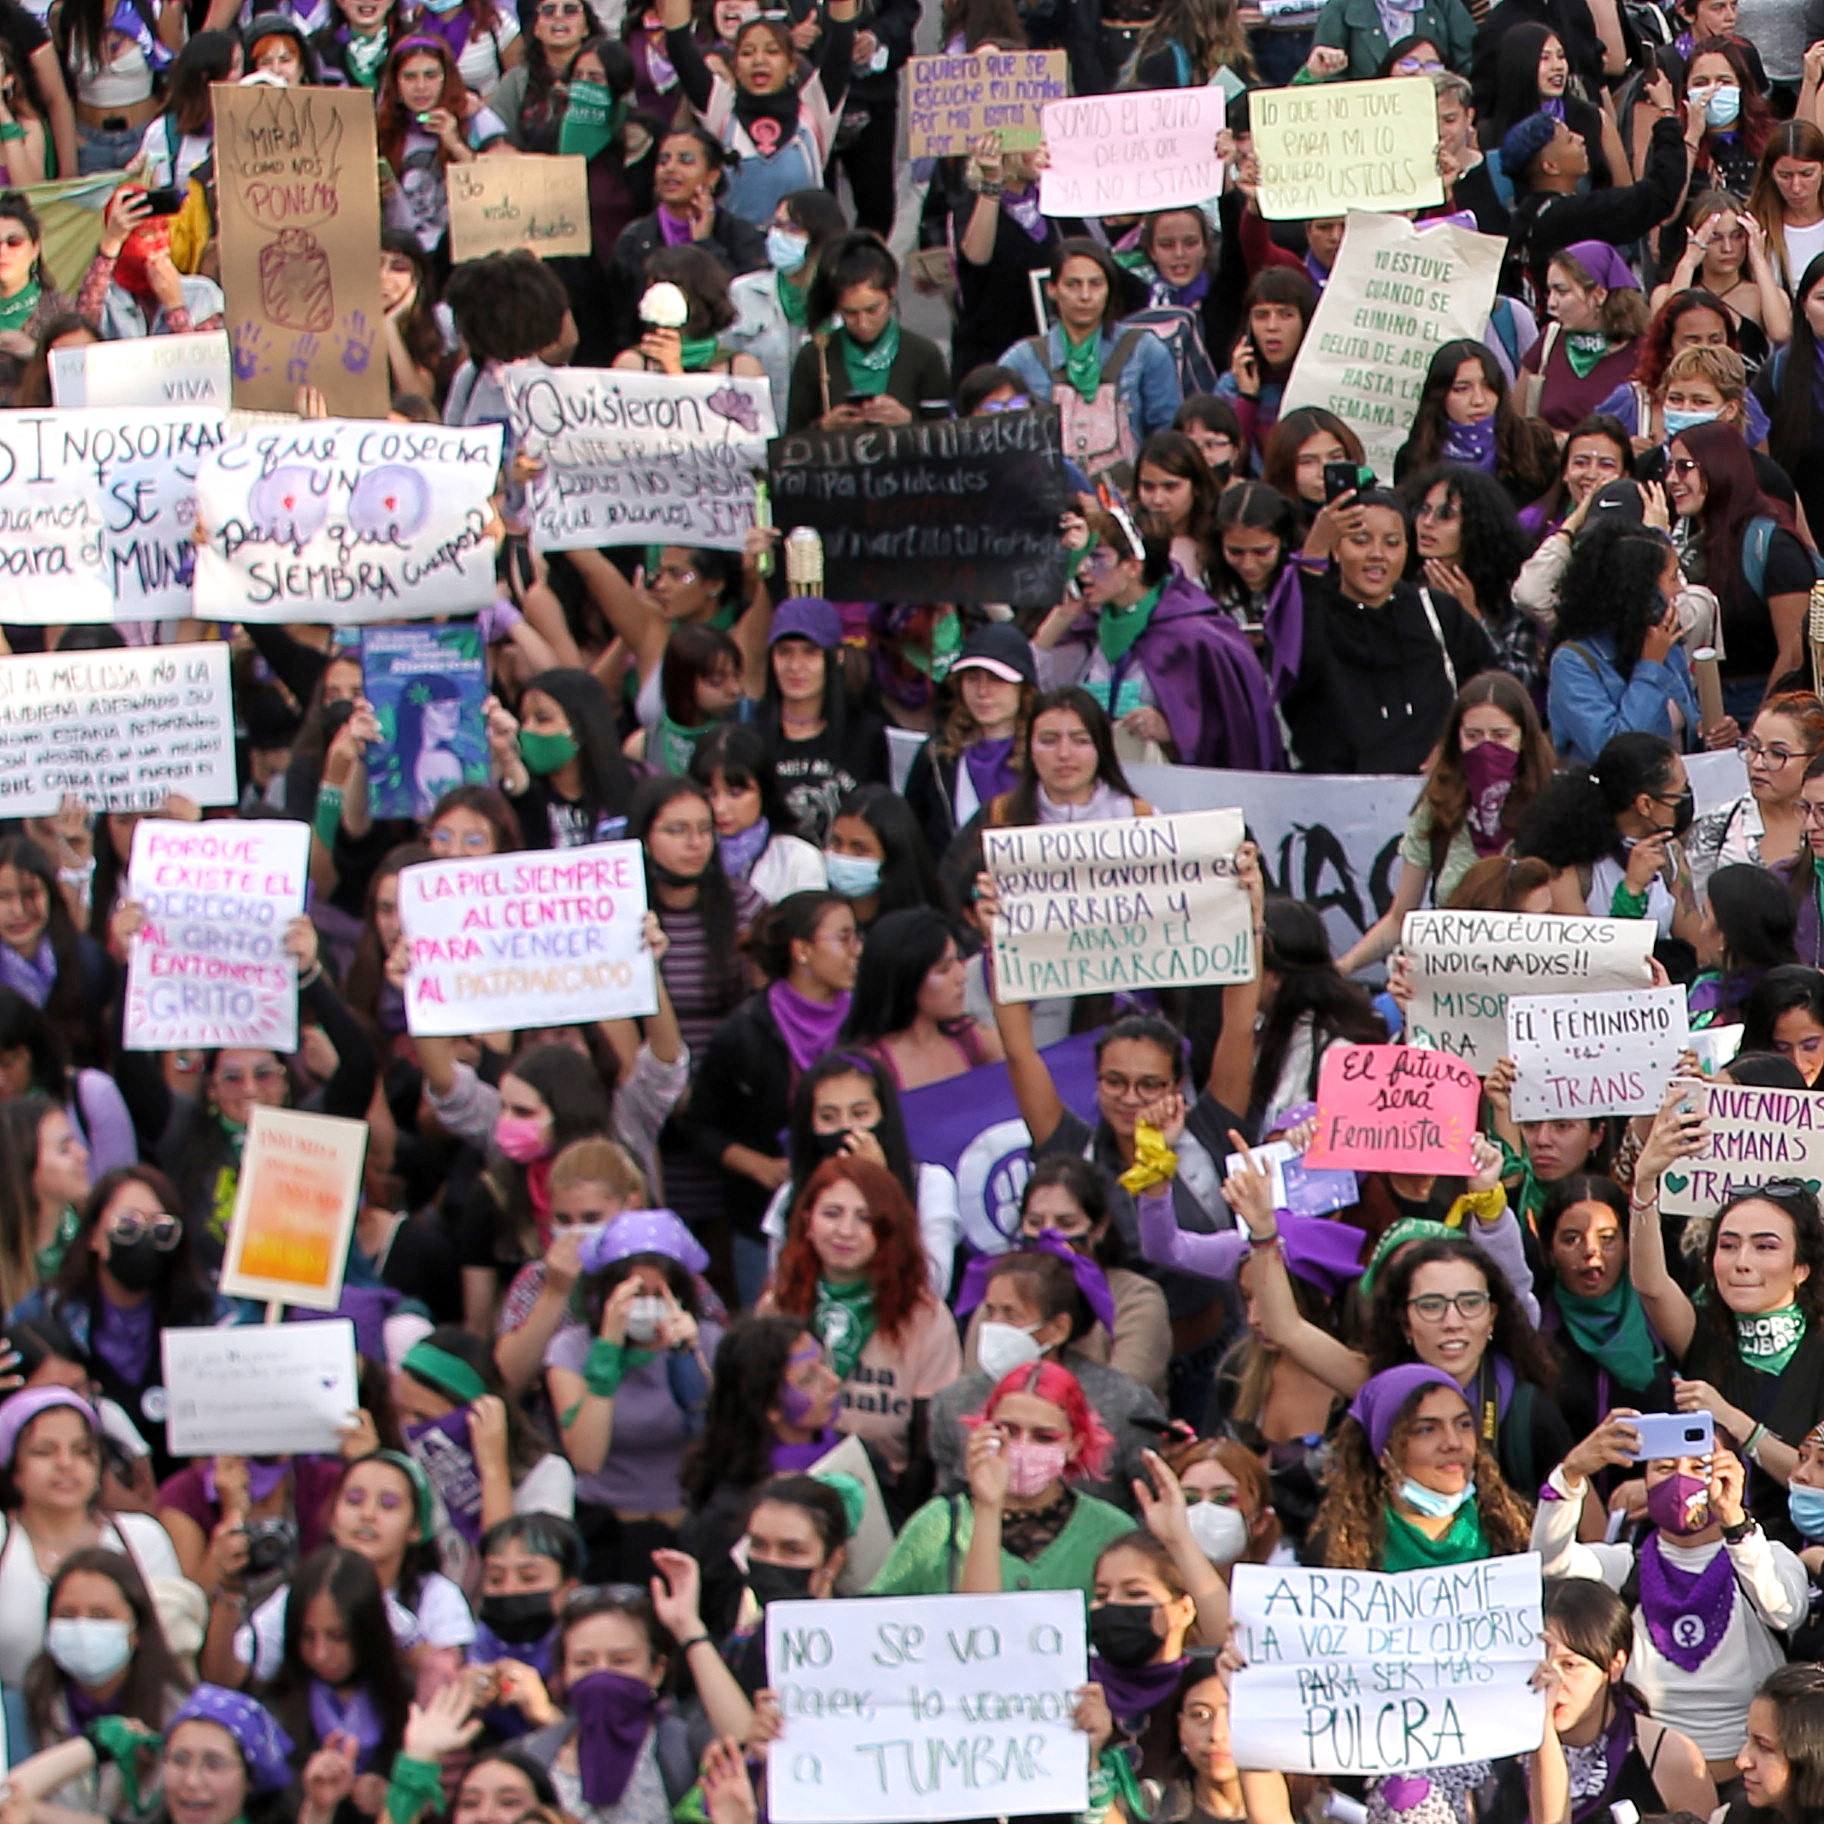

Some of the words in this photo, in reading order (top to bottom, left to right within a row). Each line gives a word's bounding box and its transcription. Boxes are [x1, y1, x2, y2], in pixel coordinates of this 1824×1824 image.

[1391, 252, 1453, 283] ESTUVE
[1365, 279, 1424, 306] CUANDO
[1431, 292, 1450, 313] SE
[148, 834, 262, 865] PORQUE
[989, 835, 1026, 865] MI
[1039, 819, 1179, 863] POSICIÓN
[511, 856, 632, 894] SIEMPRE
[464, 902, 497, 932] AL
[503, 895, 617, 927] CENTRO
[1045, 892, 1153, 930] ARRIBA
[489, 928, 600, 960] VENCER
[1068, 924, 1148, 953] ABAJO
[1164, 920, 1198, 945] EL
[1408, 914, 1617, 948] FARMACÉUTICXS
[1424, 951, 1590, 979] INDIGNADXS!!
[148, 981, 256, 1020] GRITO
[1515, 1012, 1540, 1042] EL
[1551, 1005, 1671, 1037] FEMINISMO
[1343, 1050, 1379, 1082] El
[1391, 1049, 1476, 1087] futuro
[1370, 1077, 1434, 1112] será
[1546, 1072, 1646, 1108] TRANS
[1329, 1114, 1444, 1152] Feminista
[1265, 1565, 1502, 1622] ARRANCAME
[1307, 1699, 1466, 1770] PULCRA
[856, 1732, 1049, 1795] TUMBAR
